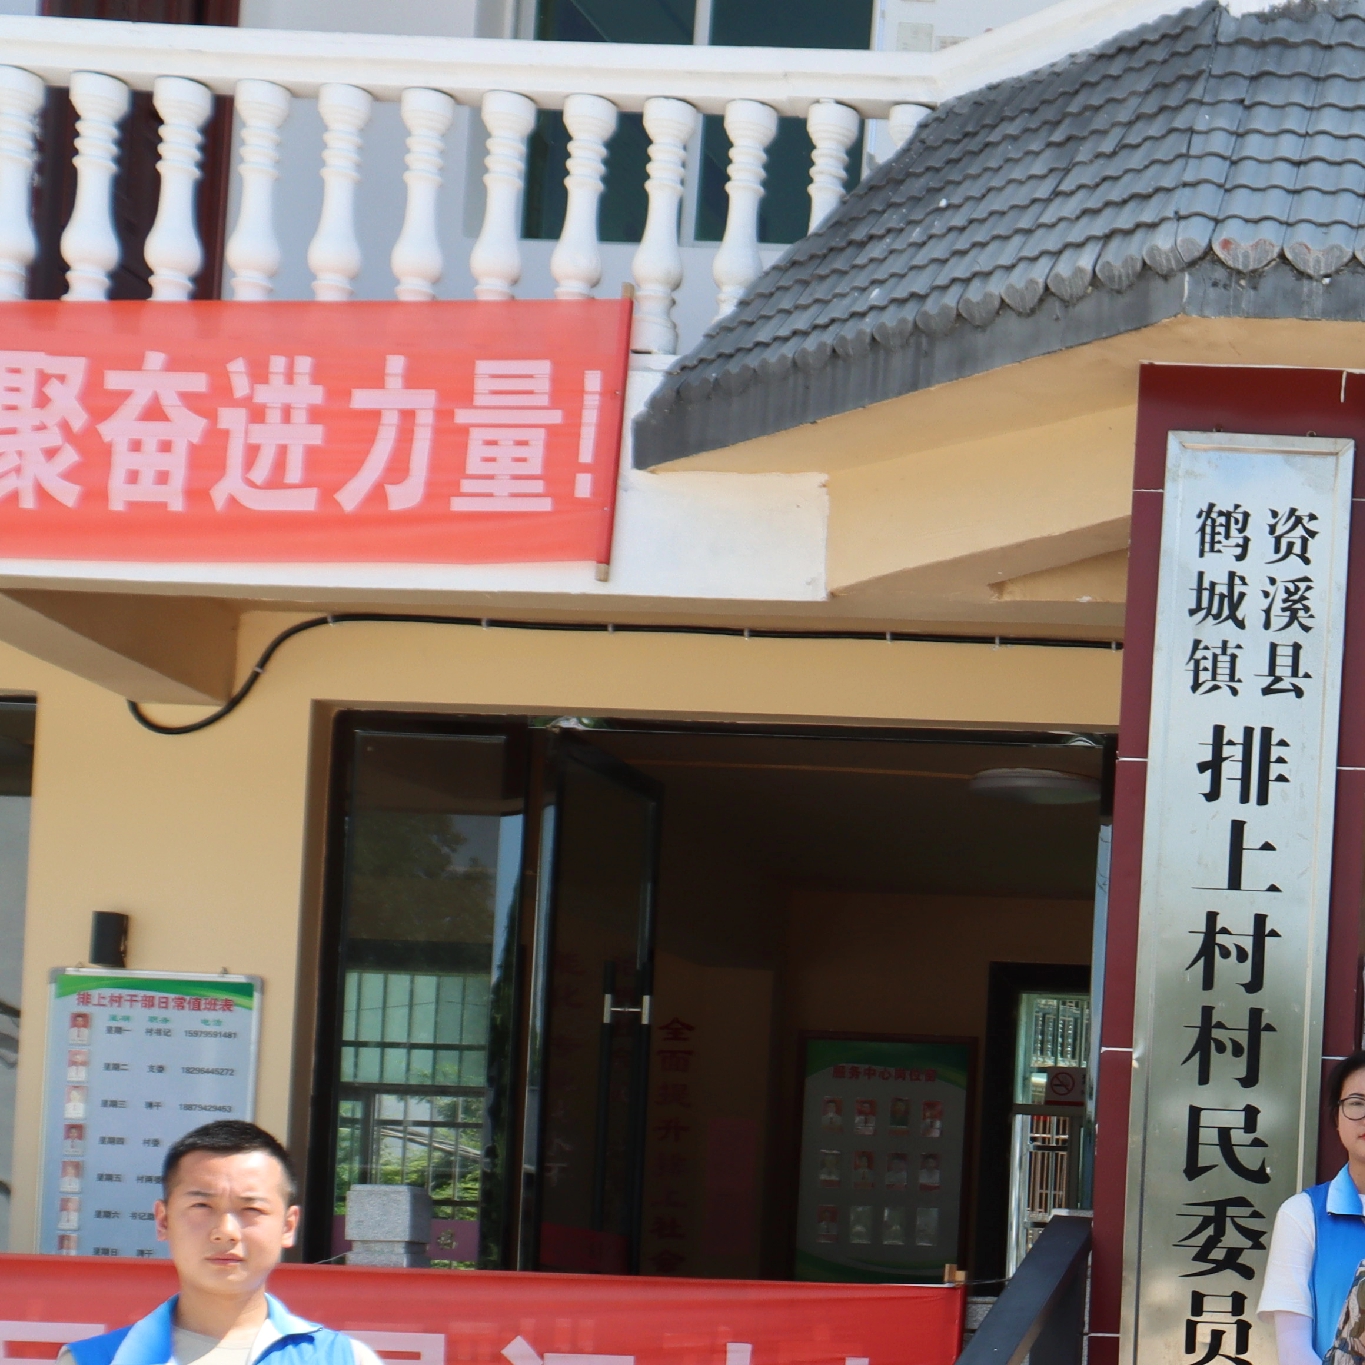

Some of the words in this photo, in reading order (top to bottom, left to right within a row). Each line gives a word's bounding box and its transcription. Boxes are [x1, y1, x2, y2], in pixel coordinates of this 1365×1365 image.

[1184, 502, 1252, 699] 鹤城镇
[1254, 506, 1320, 700] 资溪县
[76, 992, 235, 1012] 排上村干部日常值班表
[105, 1025, 132, 1035] 星期一
[103, 1062, 129, 1072] 星期二
[101, 1099, 127, 1109] 星期三
